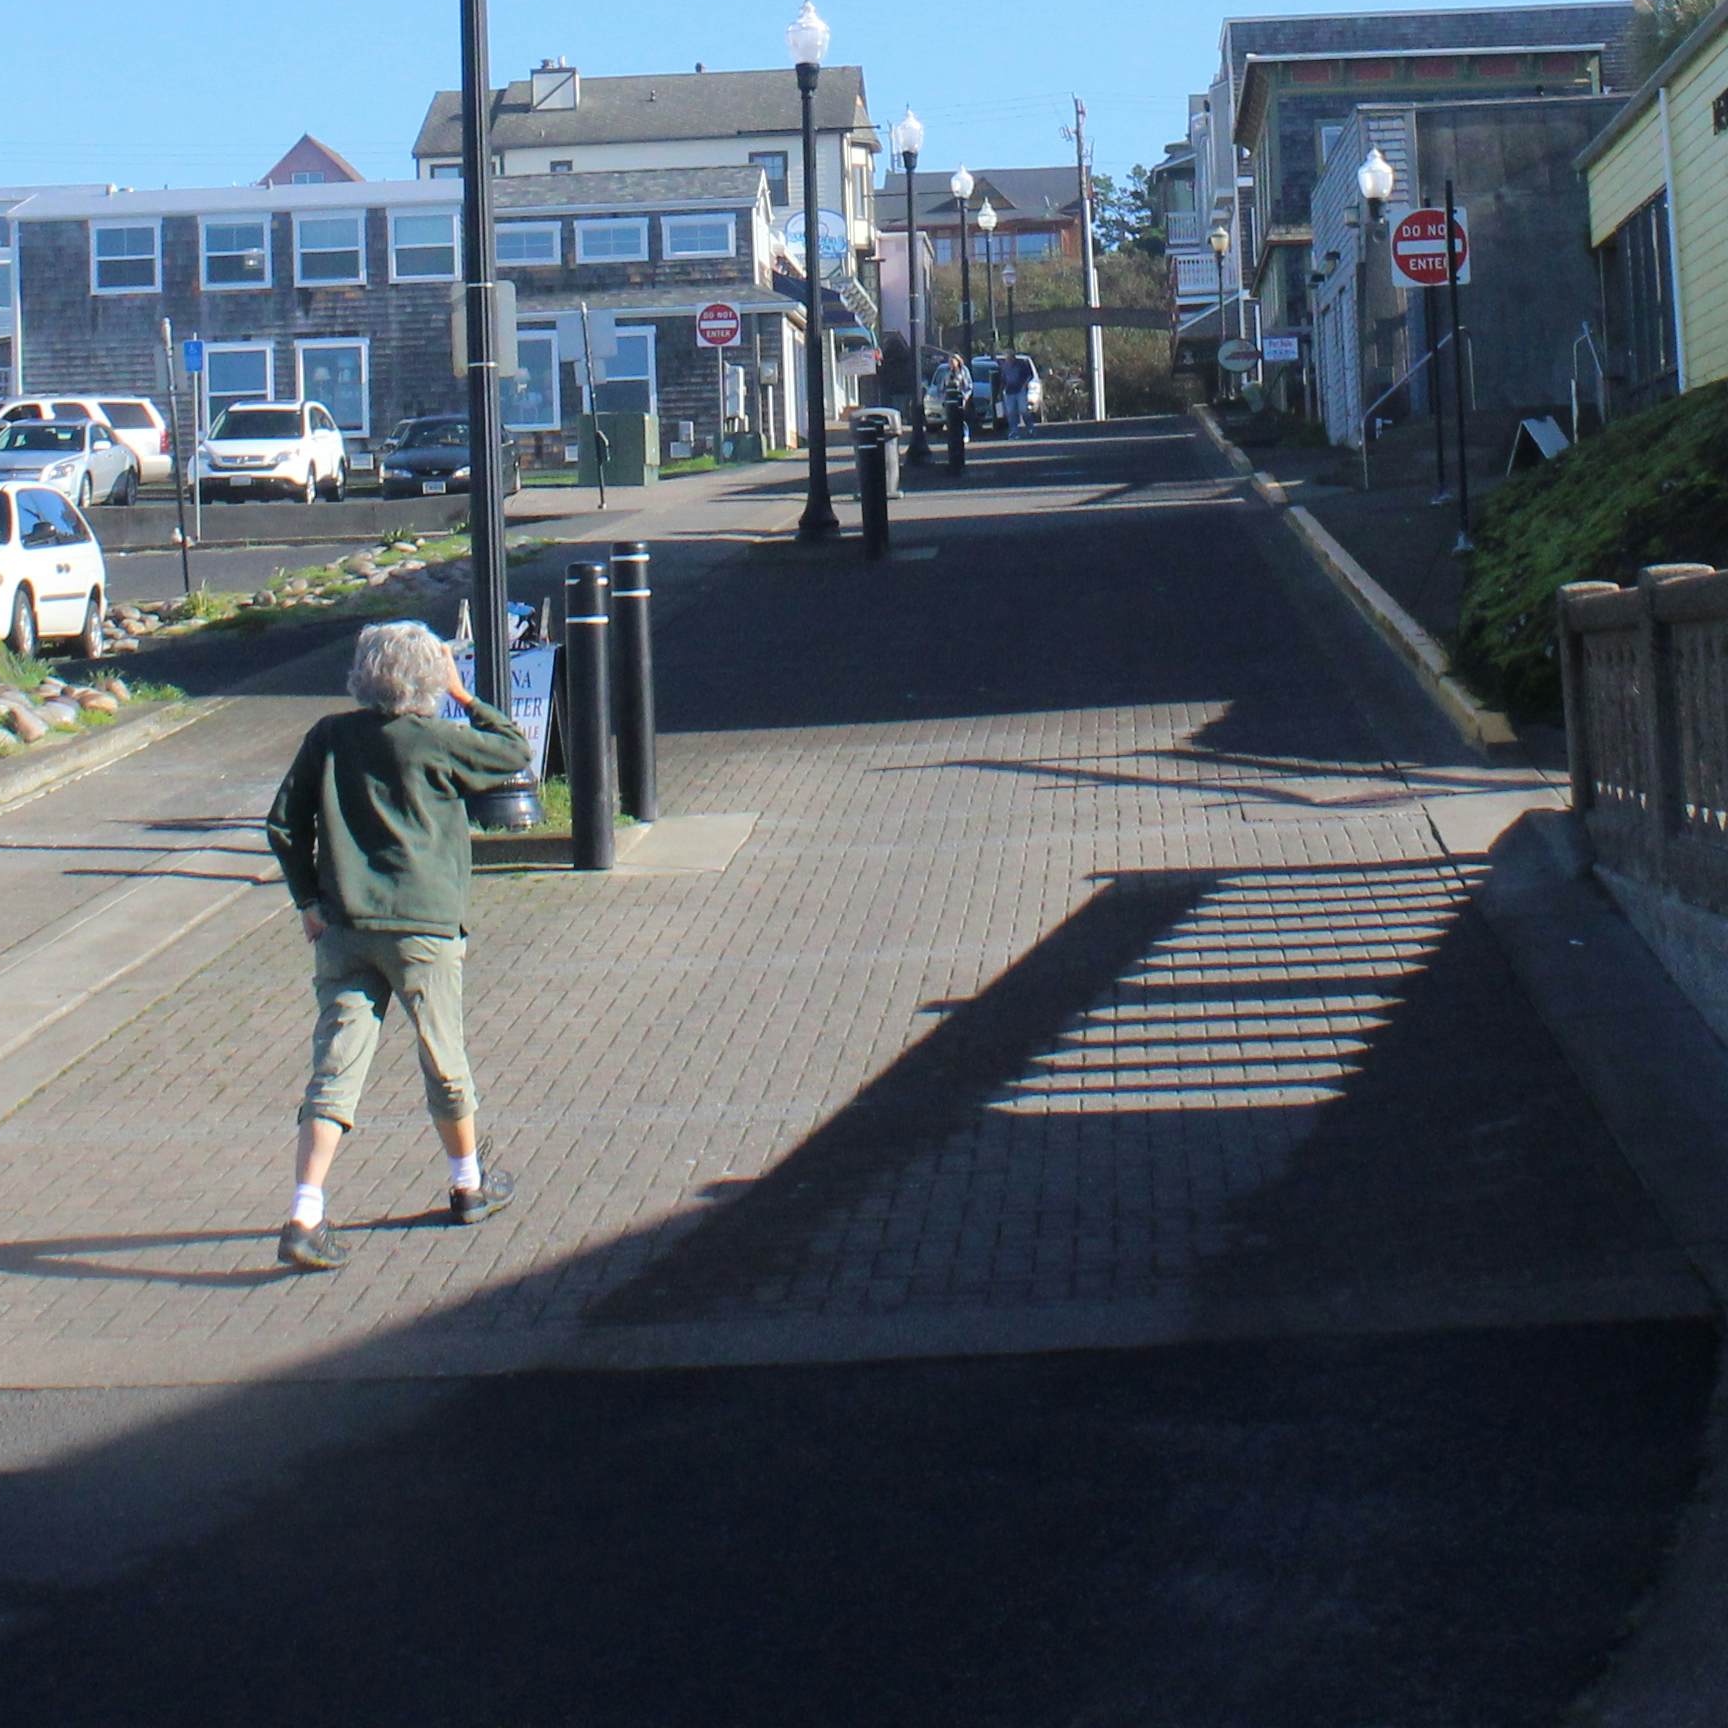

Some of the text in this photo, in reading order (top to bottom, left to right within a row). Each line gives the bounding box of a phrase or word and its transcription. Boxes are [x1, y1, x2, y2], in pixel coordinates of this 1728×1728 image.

[1402, 223, 1446, 237] DO NO
[703, 311, 733, 319] DO NOT
[706, 329, 732, 338] ENTER
